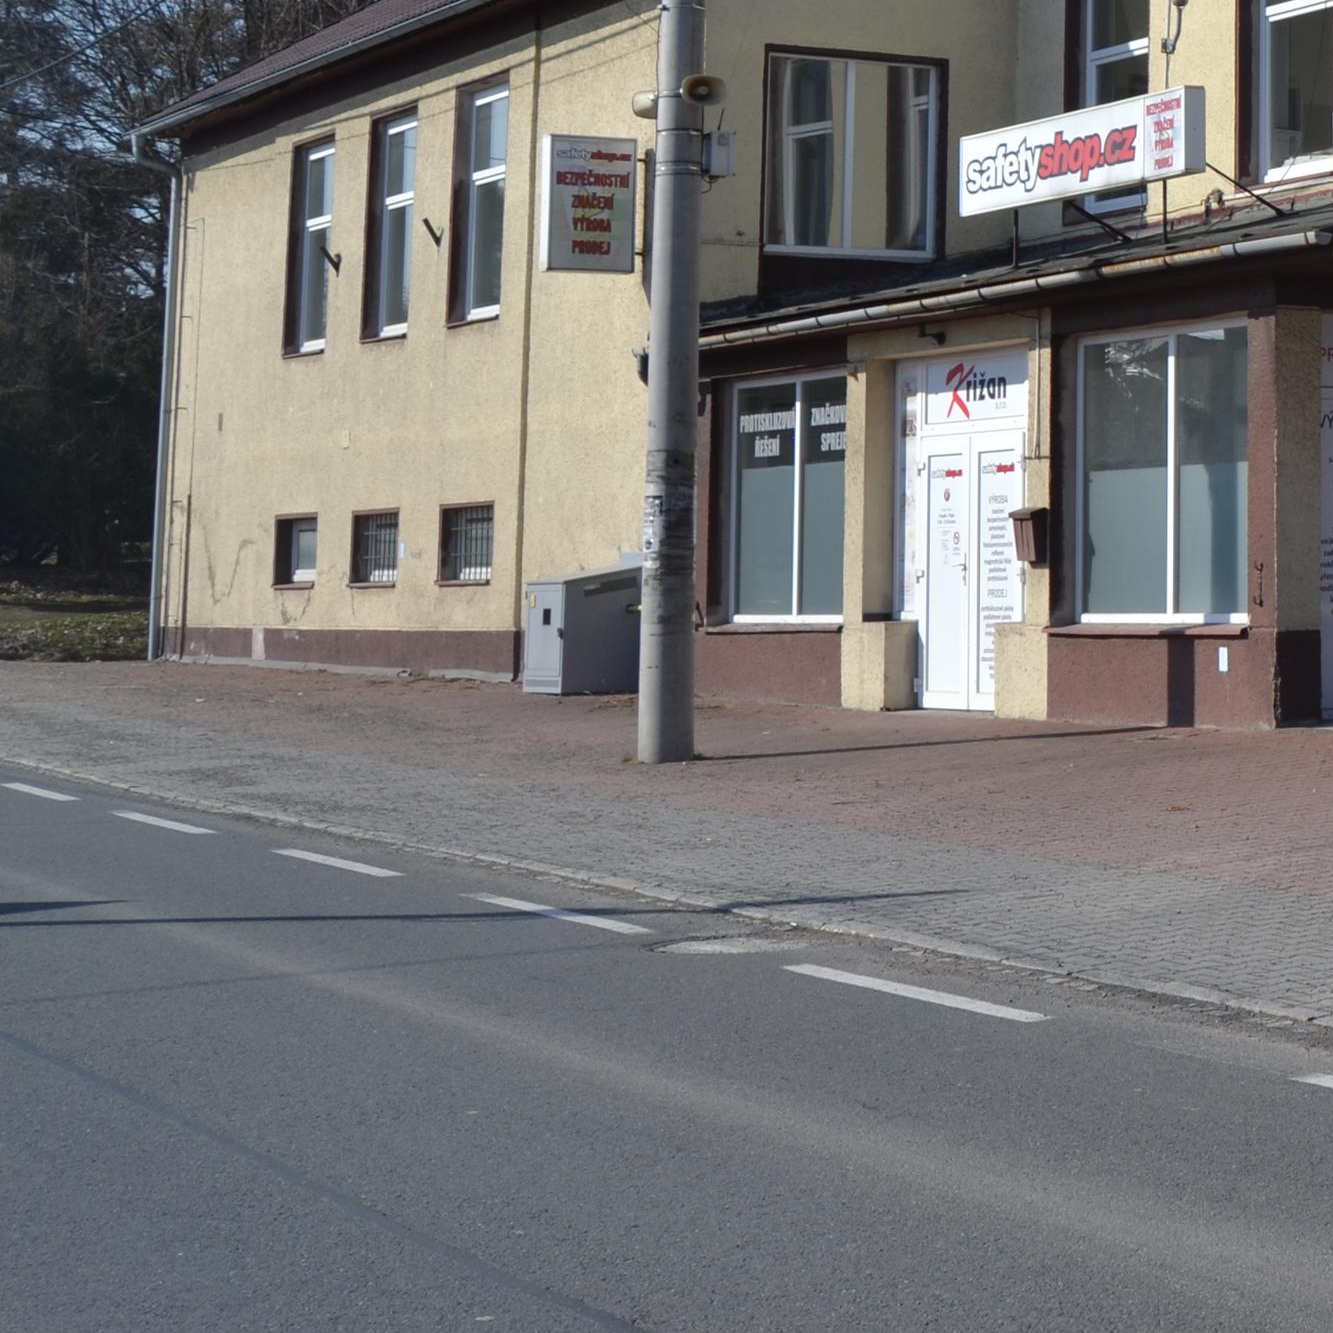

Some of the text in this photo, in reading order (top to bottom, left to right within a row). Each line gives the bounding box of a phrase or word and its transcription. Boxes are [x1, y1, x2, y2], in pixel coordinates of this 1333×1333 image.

[556, 148, 632, 163] safetyshop.cz
[965, 125, 1137, 195] safetyshop.cz
[556, 170, 630, 188] BEZPEČNOSTNÍ
[571, 192, 615, 210] ZNAČENÍ
[572, 214, 612, 233] VÝROBA
[571, 239, 611, 255] PRODEJ
[754, 435, 780, 458] ŘEŠENÍ
